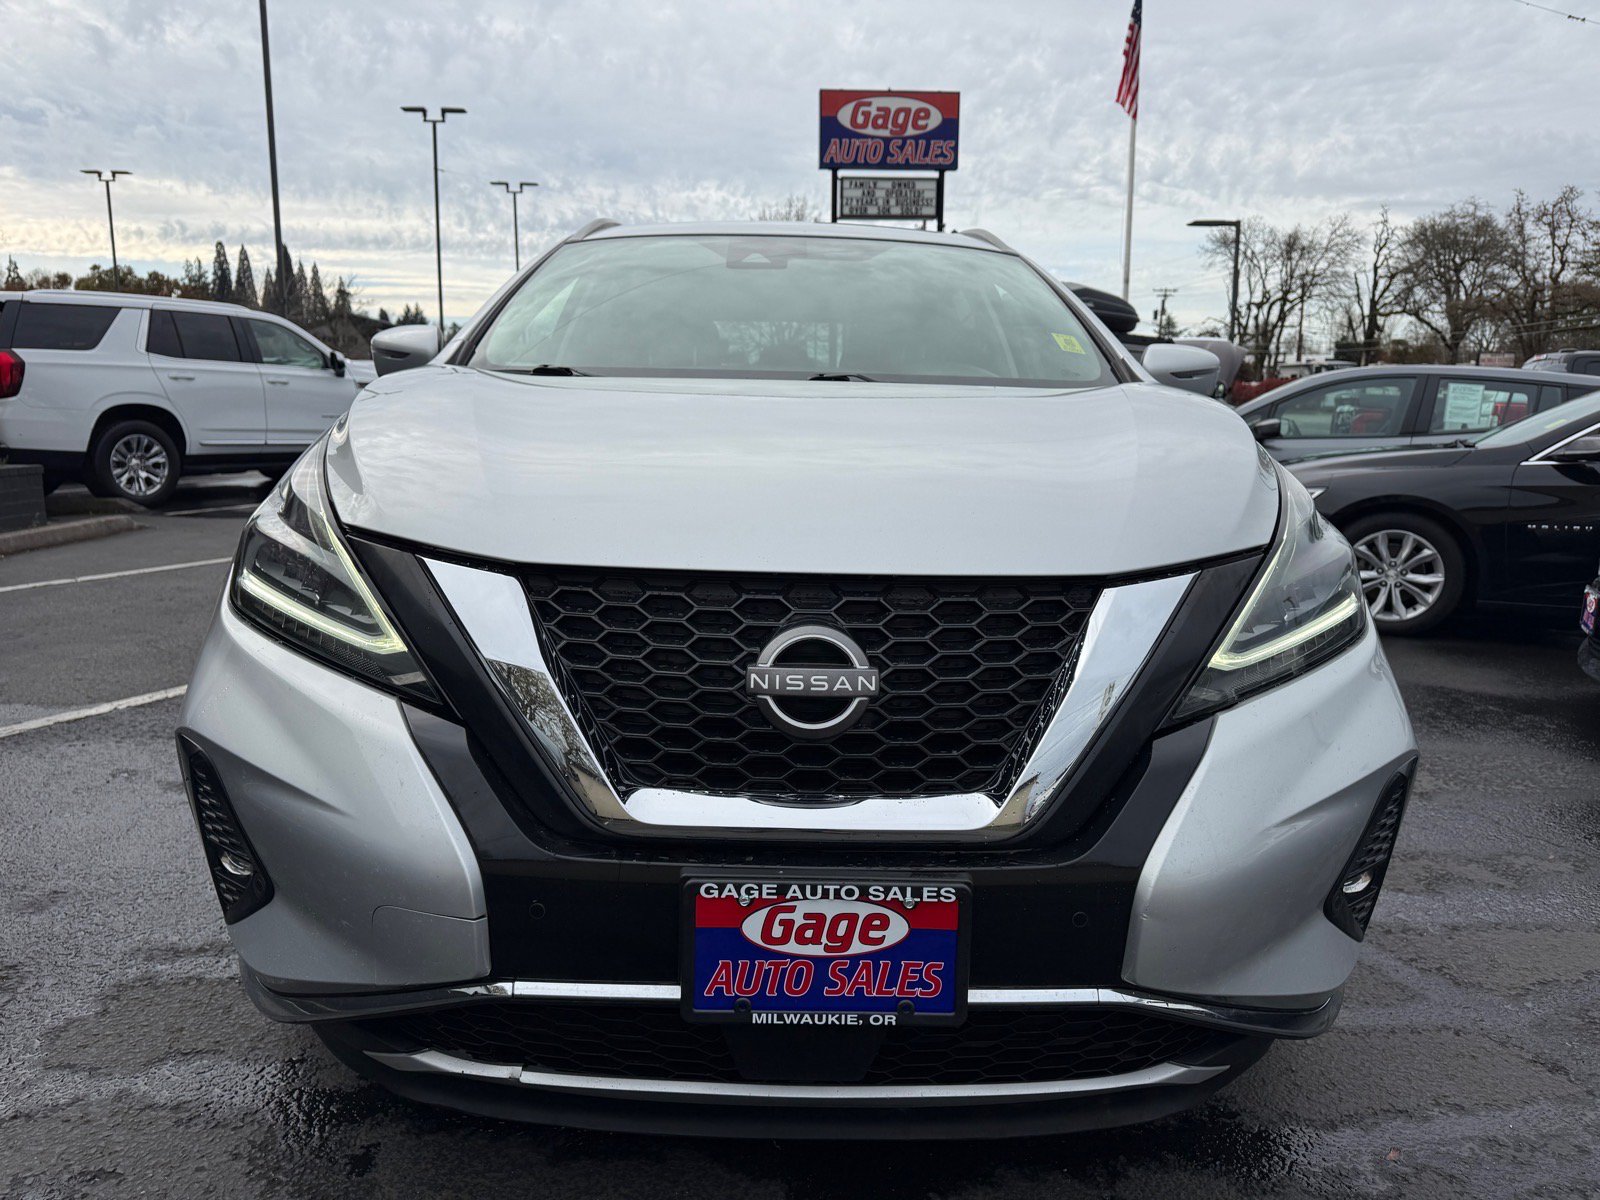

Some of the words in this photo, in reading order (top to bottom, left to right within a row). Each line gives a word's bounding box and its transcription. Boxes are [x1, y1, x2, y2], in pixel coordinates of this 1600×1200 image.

[850, 101, 931, 136] Gage
[823, 138, 884, 164] AUTO
[887, 139, 956, 165] SALES
[750, 673, 876, 691] NISSAN
[700, 883, 778, 899] GAGE
[785, 885, 860, 901] AUTO
[868, 886, 956, 903] SALES
[760, 905, 890, 953] Gage
[704, 959, 814, 997] AUTO
[823, 960, 944, 998] SALES
[752, 1013, 864, 1026] MILWAUKIE,
[869, 1014, 897, 1026] OR
